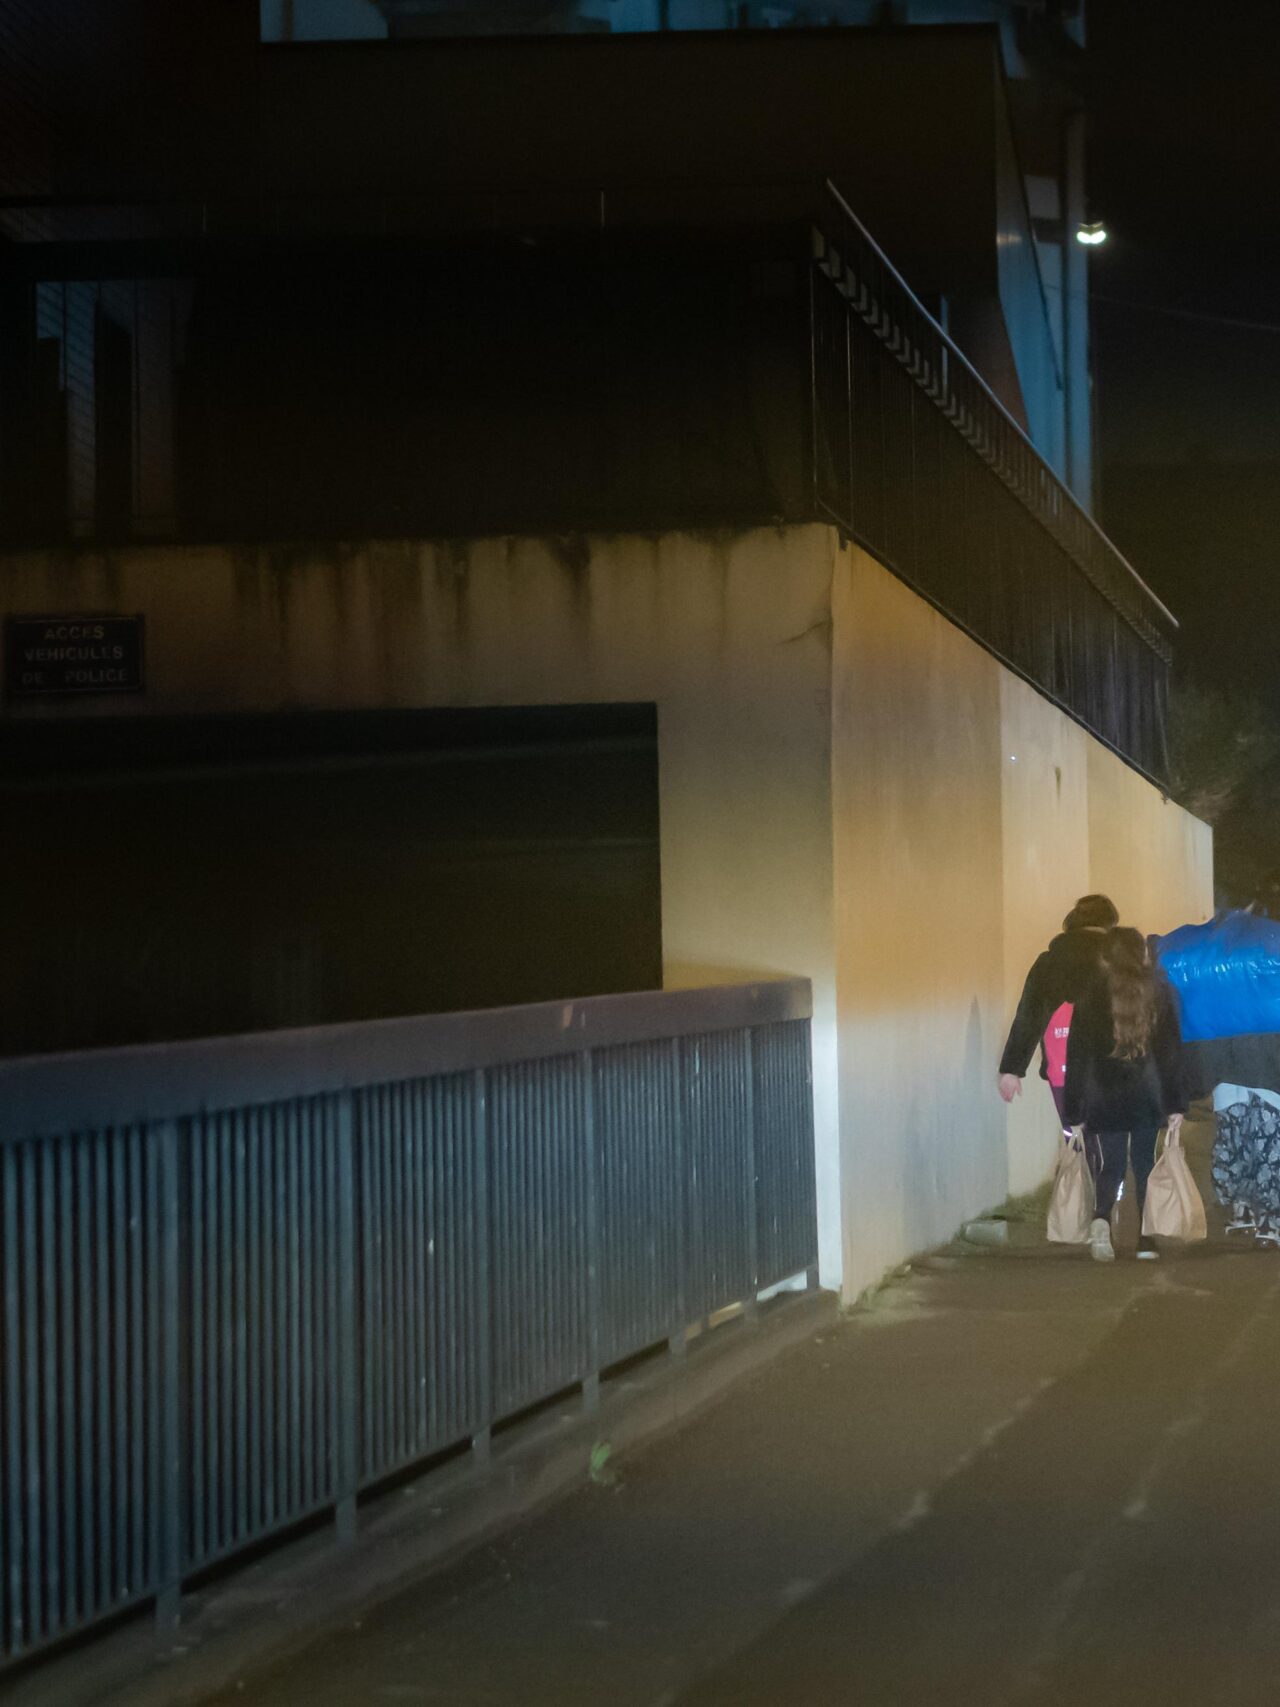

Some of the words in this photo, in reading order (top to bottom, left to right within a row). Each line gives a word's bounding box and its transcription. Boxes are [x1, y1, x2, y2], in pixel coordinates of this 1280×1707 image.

[44, 625, 105, 640] ACCES
[24, 646, 124, 661] VEHICULES
[22, 671, 43, 685] DE
[65, 667, 128, 683] POLICE
